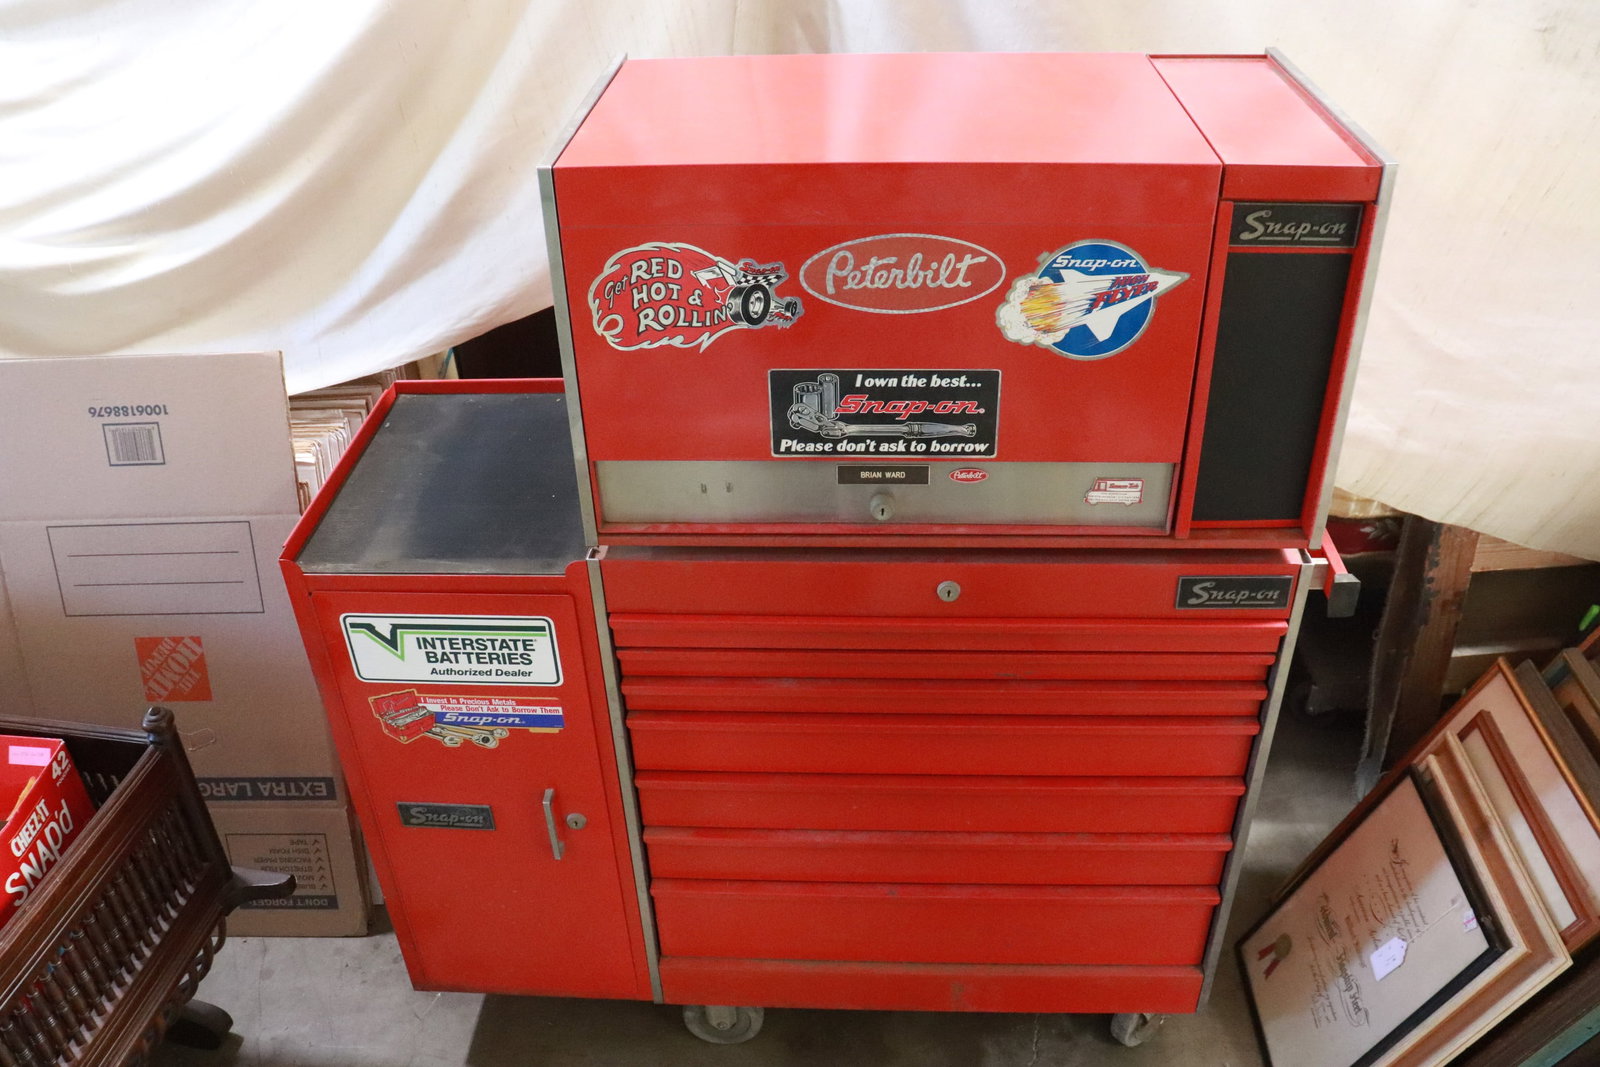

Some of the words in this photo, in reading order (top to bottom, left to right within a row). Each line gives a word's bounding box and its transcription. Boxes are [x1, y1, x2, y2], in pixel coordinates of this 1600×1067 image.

[1239, 210, 1348, 240] Snap-on
[630, 257, 683, 284] RED
[1052, 255, 1138, 271] Snap-on
[826, 250, 988, 295] Peterbilt
[1111, 274, 1150, 289] HIGH
[604, 275, 630, 309] Get
[631, 282, 682, 309] HOT
[688, 290, 703, 307] &
[1092, 281, 1159, 310] FLYER
[855, 374, 863, 388] I
[864, 377, 898, 388] own
[901, 374, 927, 388] the
[929, 374, 983, 388] best...
[88, 404, 169, 418] 1006188676
[779, 439, 833, 452] Please
[836, 439, 876, 453] don't
[879, 439, 907, 453] ask
[910, 440, 927, 453] to
[930, 439, 990, 453] borrow
[860, 471, 882, 479] BRIAN
[885, 471, 906, 479] WARD
[1187, 582, 1281, 605] Snap-on
[416, 637, 536, 652] INTERSTATE
[425, 651, 533, 666] BATTERIES
[430, 667, 493, 678] Authorized
[495, 668, 534, 678] Dealer
[511, 706, 538, 714] Borrow
[442, 712, 522, 725] Snap-on
[51, 751, 69, 779] 42
[199, 782, 252, 797] LARG
[257, 782, 328, 797] EXTRA
[410, 807, 484, 826] Snap-on
